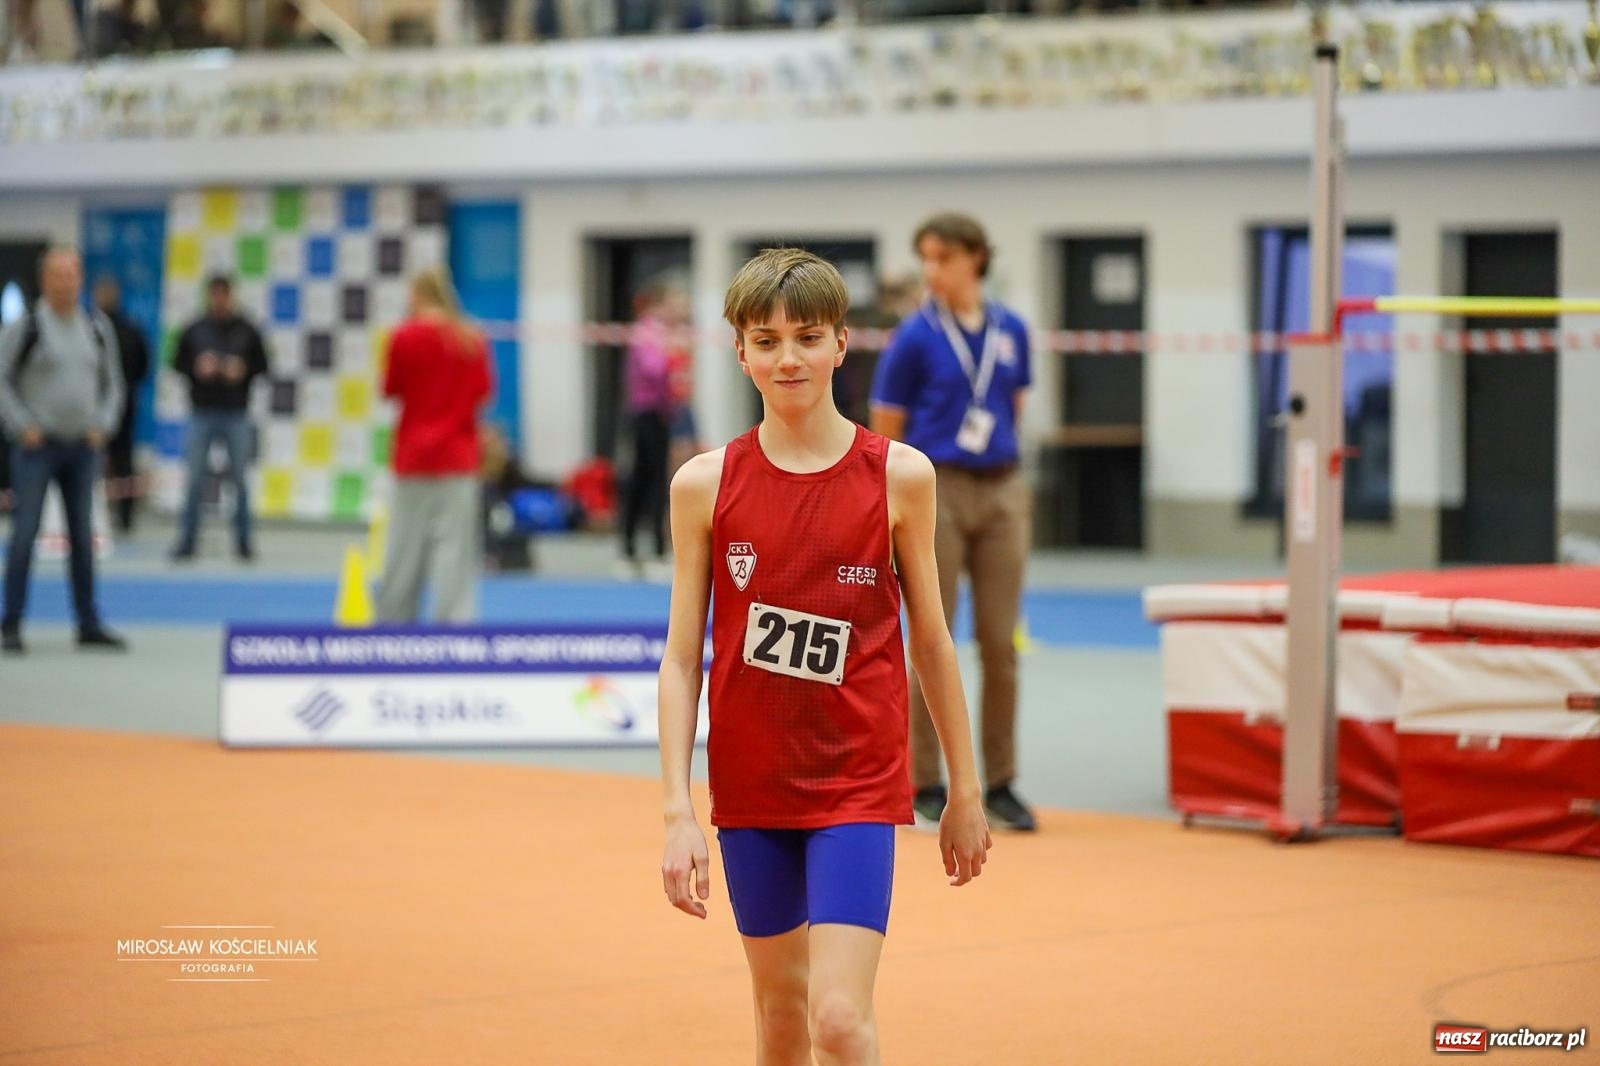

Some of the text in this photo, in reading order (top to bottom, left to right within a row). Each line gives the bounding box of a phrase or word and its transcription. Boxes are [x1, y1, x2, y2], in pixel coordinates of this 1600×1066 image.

[731, 545, 748, 554] CKS
[735, 557, 747, 579] B
[491, 634, 649, 663] SPORTOWEGO
[753, 612, 841, 675] 215
